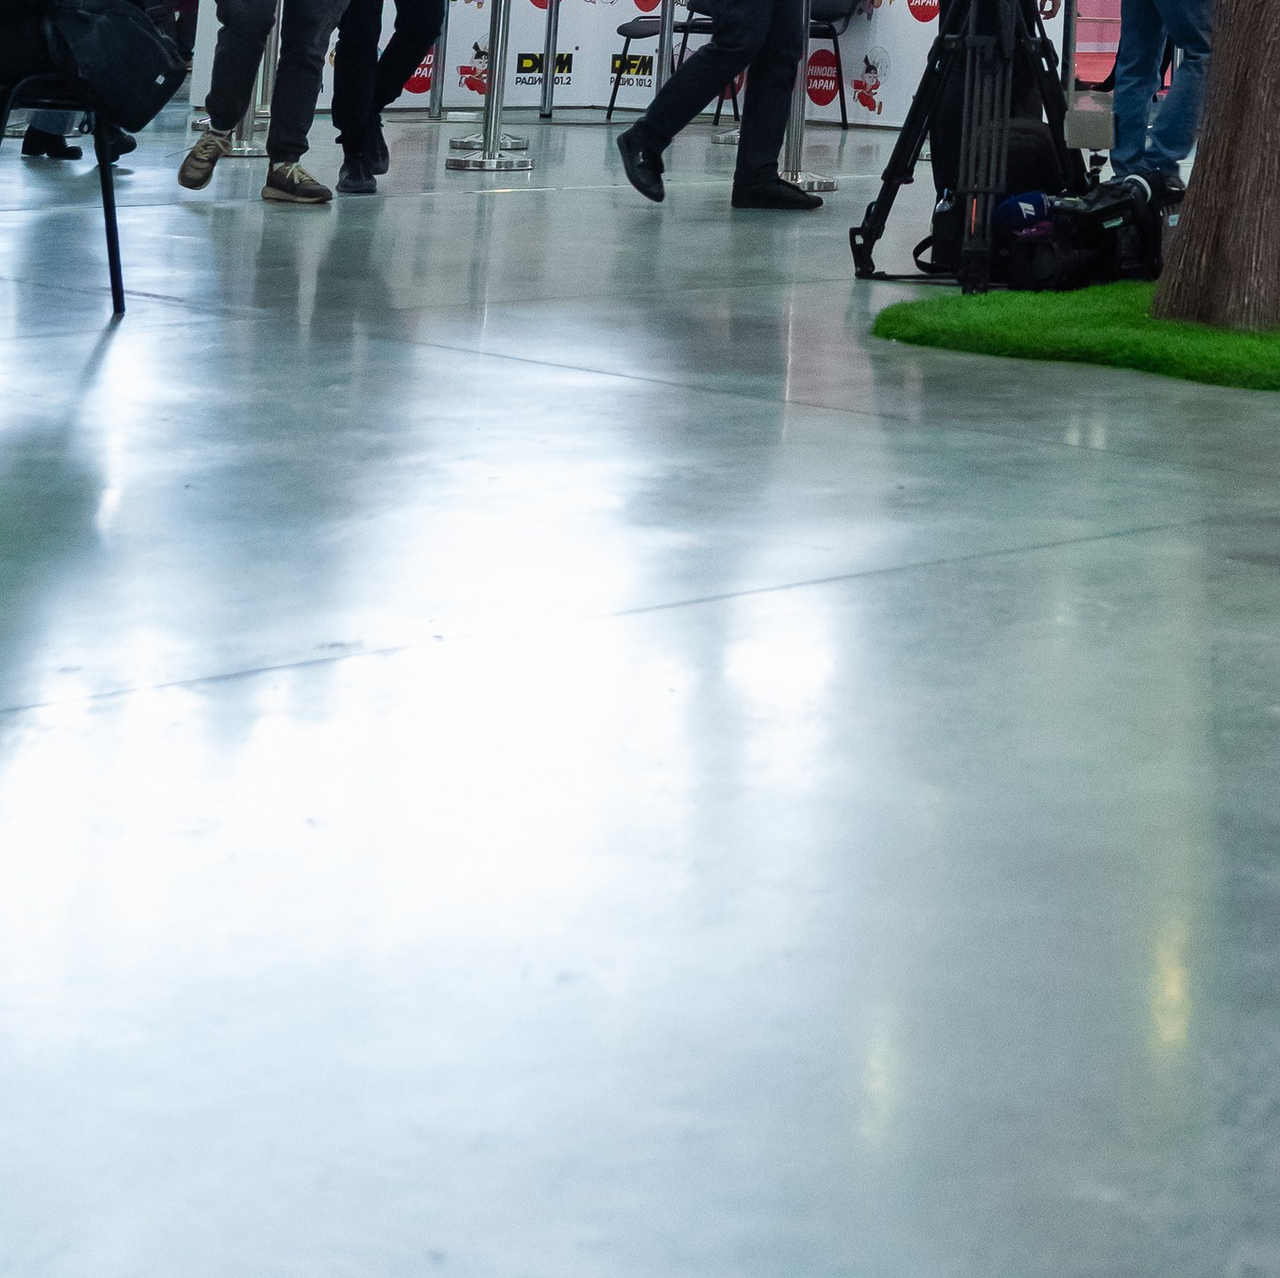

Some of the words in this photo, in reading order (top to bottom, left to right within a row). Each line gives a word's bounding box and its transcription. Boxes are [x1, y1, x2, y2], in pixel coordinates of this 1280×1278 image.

[611, 54, 653, 76] DFM
[807, 65, 836, 77] HINODE
[515, 76, 543, 85] РАДИ
[554, 76, 571, 85] 01.2
[635, 78, 652, 87] 101.2
[807, 78, 835, 90] JAPAN
